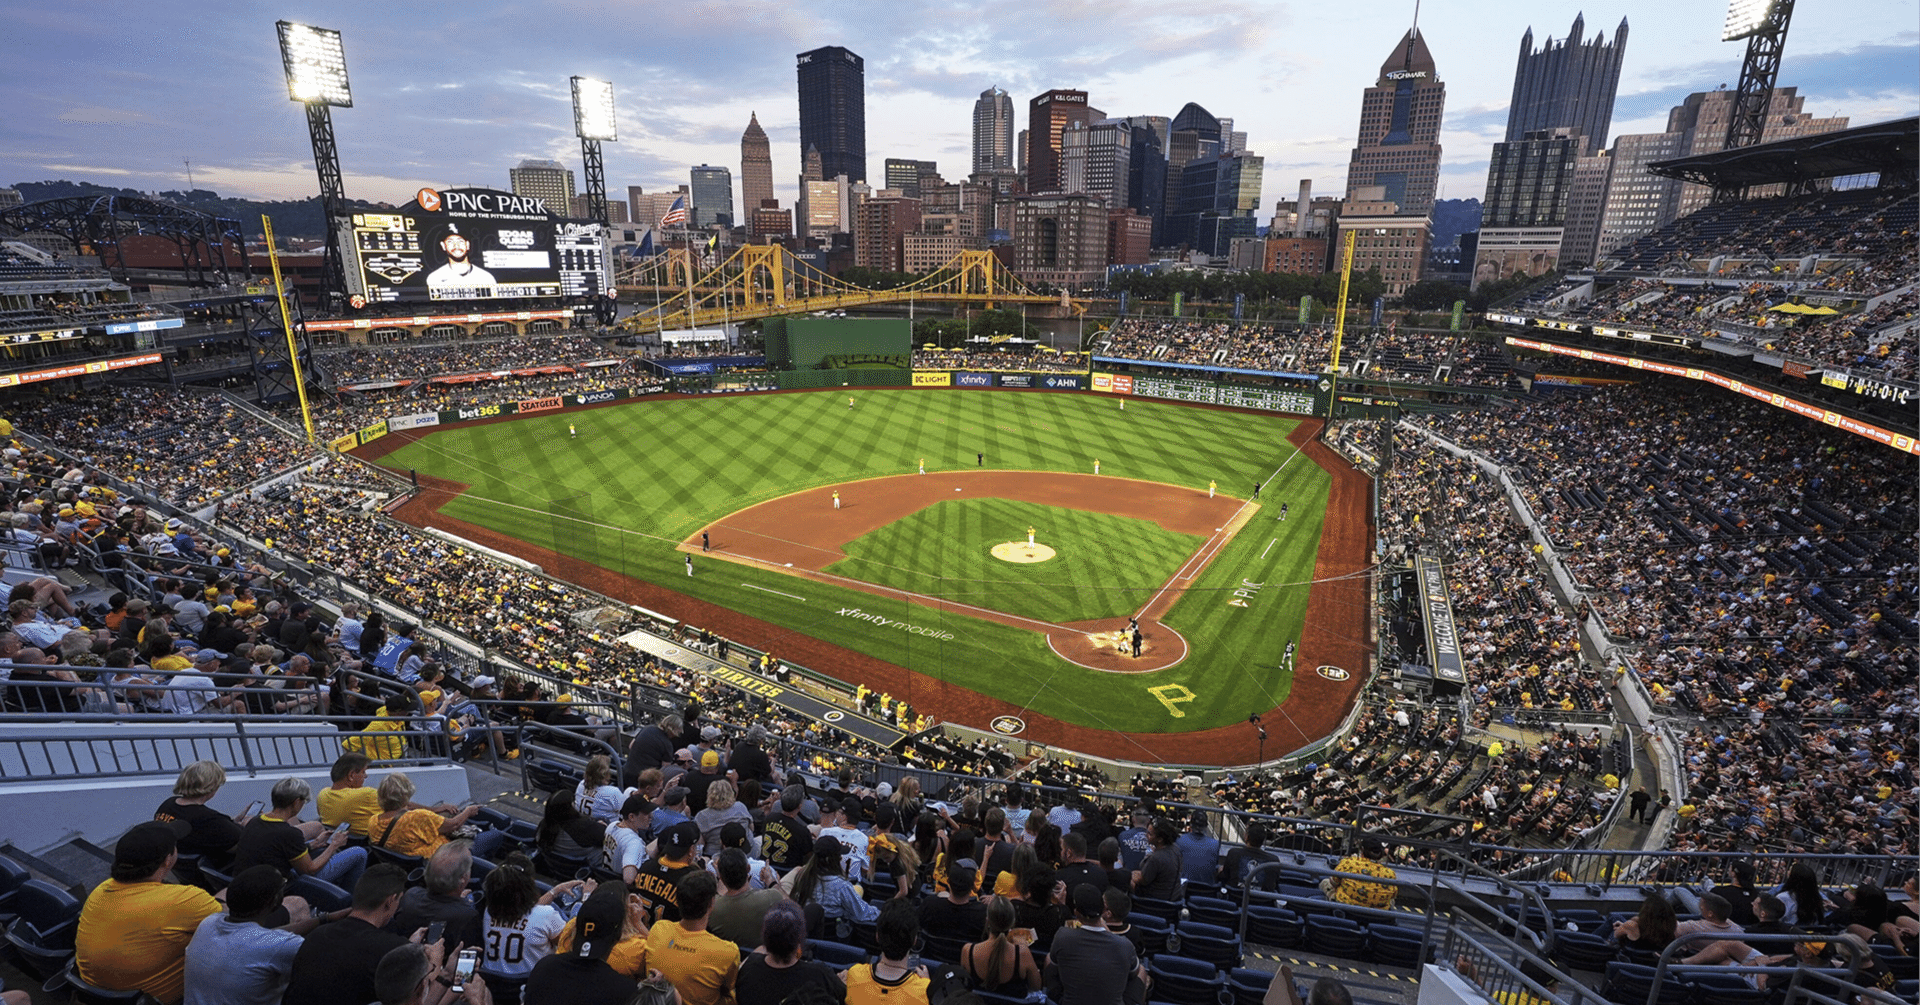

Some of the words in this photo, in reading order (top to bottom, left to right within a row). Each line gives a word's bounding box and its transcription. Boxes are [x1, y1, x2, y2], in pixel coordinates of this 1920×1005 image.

[1390, 71, 1426, 80] HIGHMARK
[444, 192, 492, 212] PNC
[496, 195, 548, 214] PARK
[565, 223, 600, 236] Chicago
[499, 238, 534, 246] QUERO
[961, 375, 987, 385] xfinity
[1057, 379, 1076, 387] AHN
[638, 386, 663, 394] BETMGM
[521, 399, 560, 411] SEATGEEK
[458, 405, 500, 419] bet365
[416, 416, 435, 425] paze
[1426, 570, 1441, 583] PARK
[1233, 578, 1264, 599] PNC
[1428, 584, 1442, 596] PNC
[1431, 602, 1446, 613] TO
[835, 608, 893, 626] xfinity
[892, 622, 954, 641] mobile
[1433, 614, 1456, 654] WELCOME
[711, 667, 784, 698] PIRATES
[1147, 683, 1197, 718] P
[762, 833, 788, 863] 22
[635, 872, 680, 908] RENEGAD
[584, 922, 595, 936] P
[487, 930, 526, 963] 30
